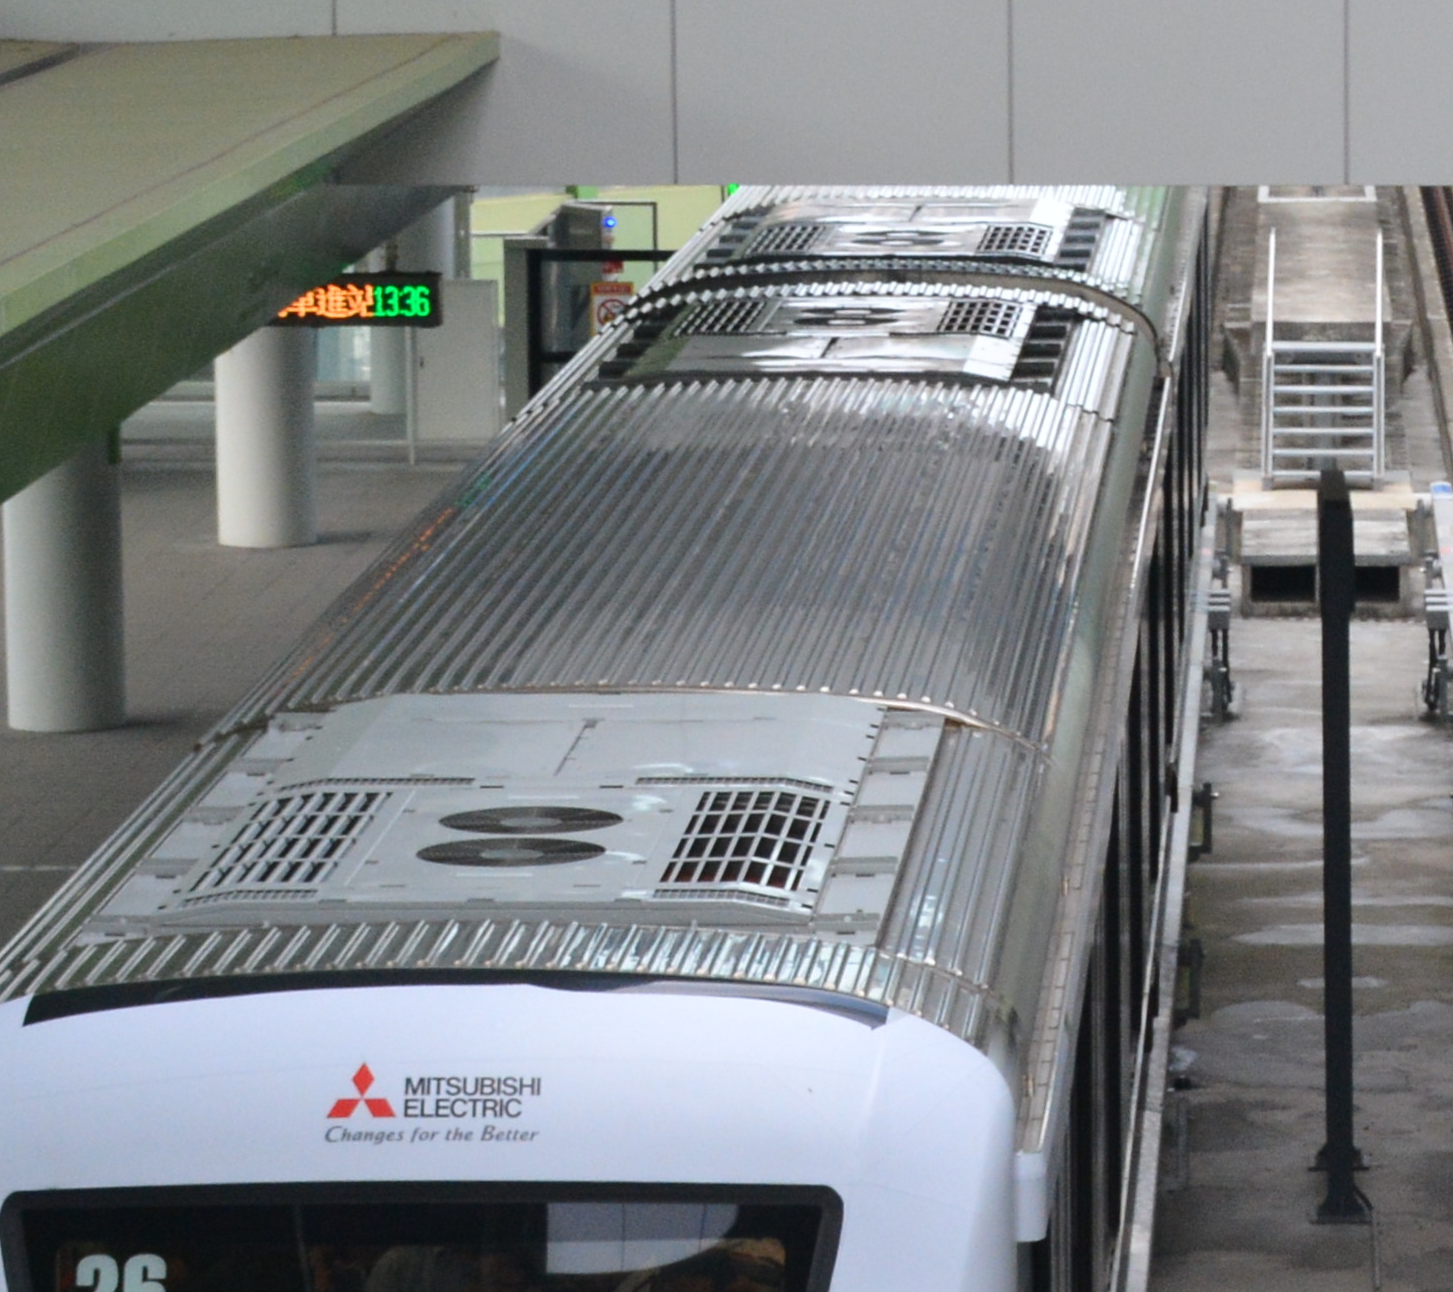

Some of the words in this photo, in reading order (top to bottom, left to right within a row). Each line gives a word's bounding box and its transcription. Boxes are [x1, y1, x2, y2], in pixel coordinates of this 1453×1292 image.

[278, 283, 375, 319] 車進站
[375, 285, 431, 317] 13:36
[403, 1076, 541, 1097] MITSUBISHI
[403, 1098, 522, 1119] ELECTRIC
[325, 1124, 404, 1145] Changes
[410, 1126, 439, 1143] for
[446, 1127, 474, 1142] the
[480, 1124, 539, 1143] Better
